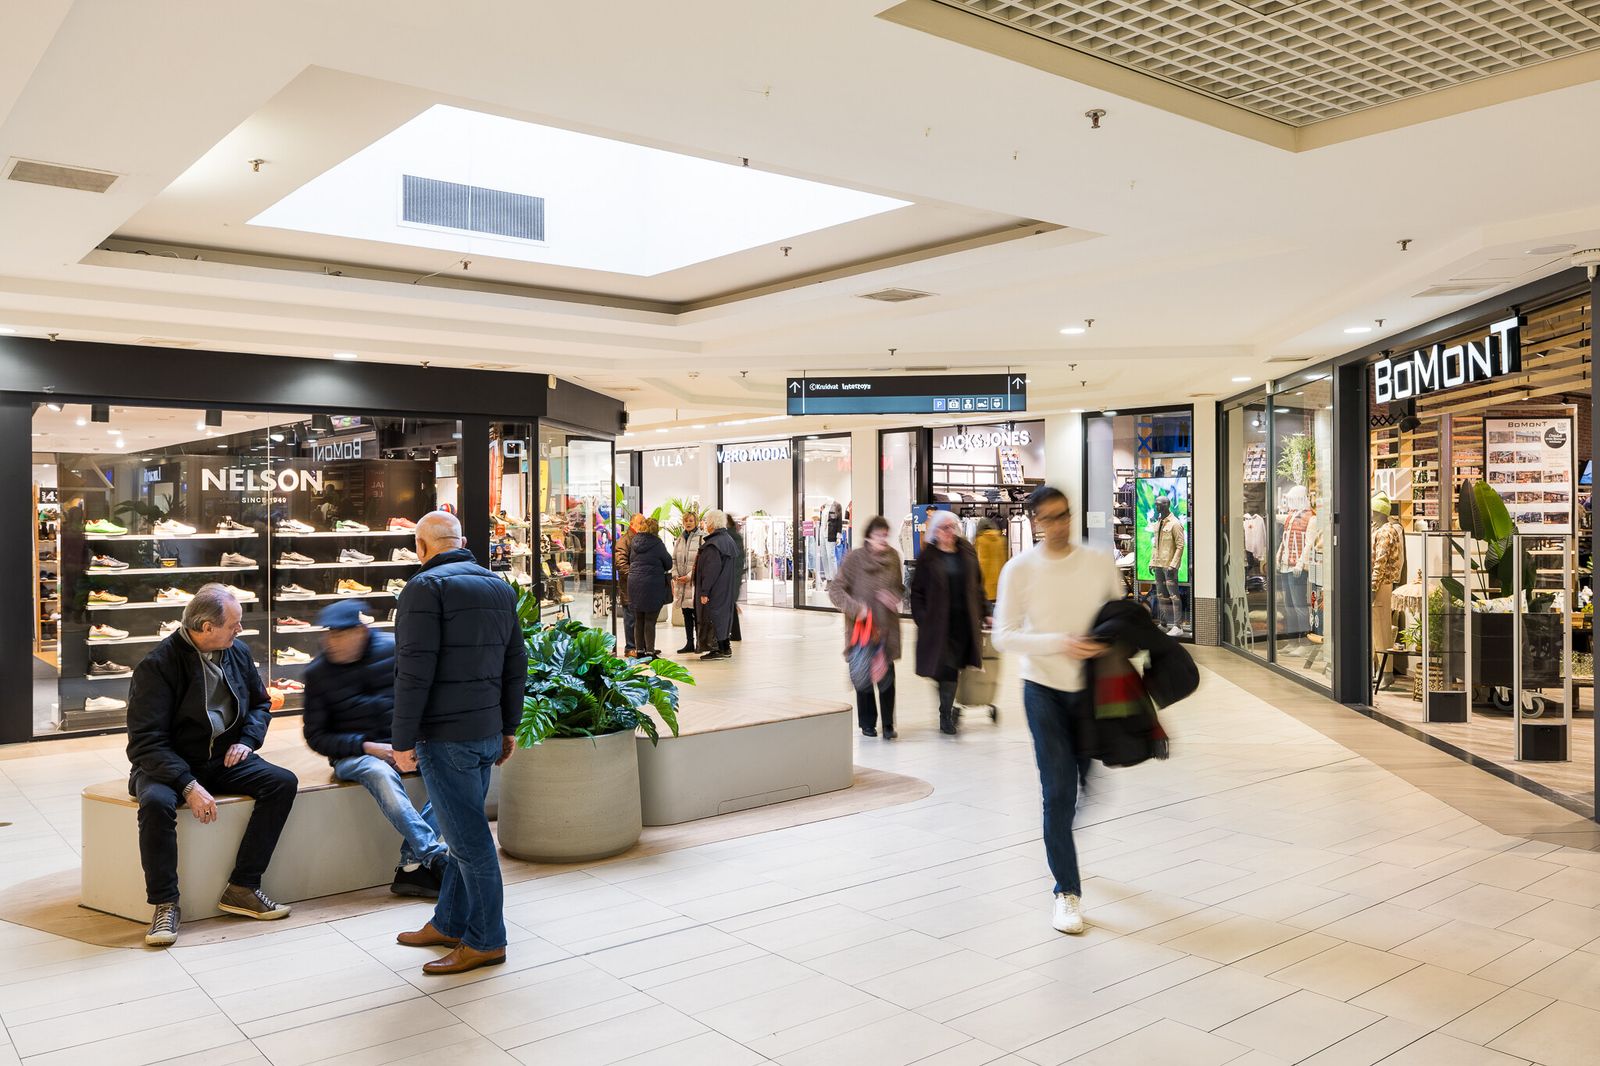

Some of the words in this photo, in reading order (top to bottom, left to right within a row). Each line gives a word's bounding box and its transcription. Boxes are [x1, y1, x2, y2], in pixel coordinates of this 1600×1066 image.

[653, 454, 683, 467] VILA
[717, 449, 748, 464] VERO
[750, 447, 790, 461] MODA
[201, 468, 323, 492] NELSON
